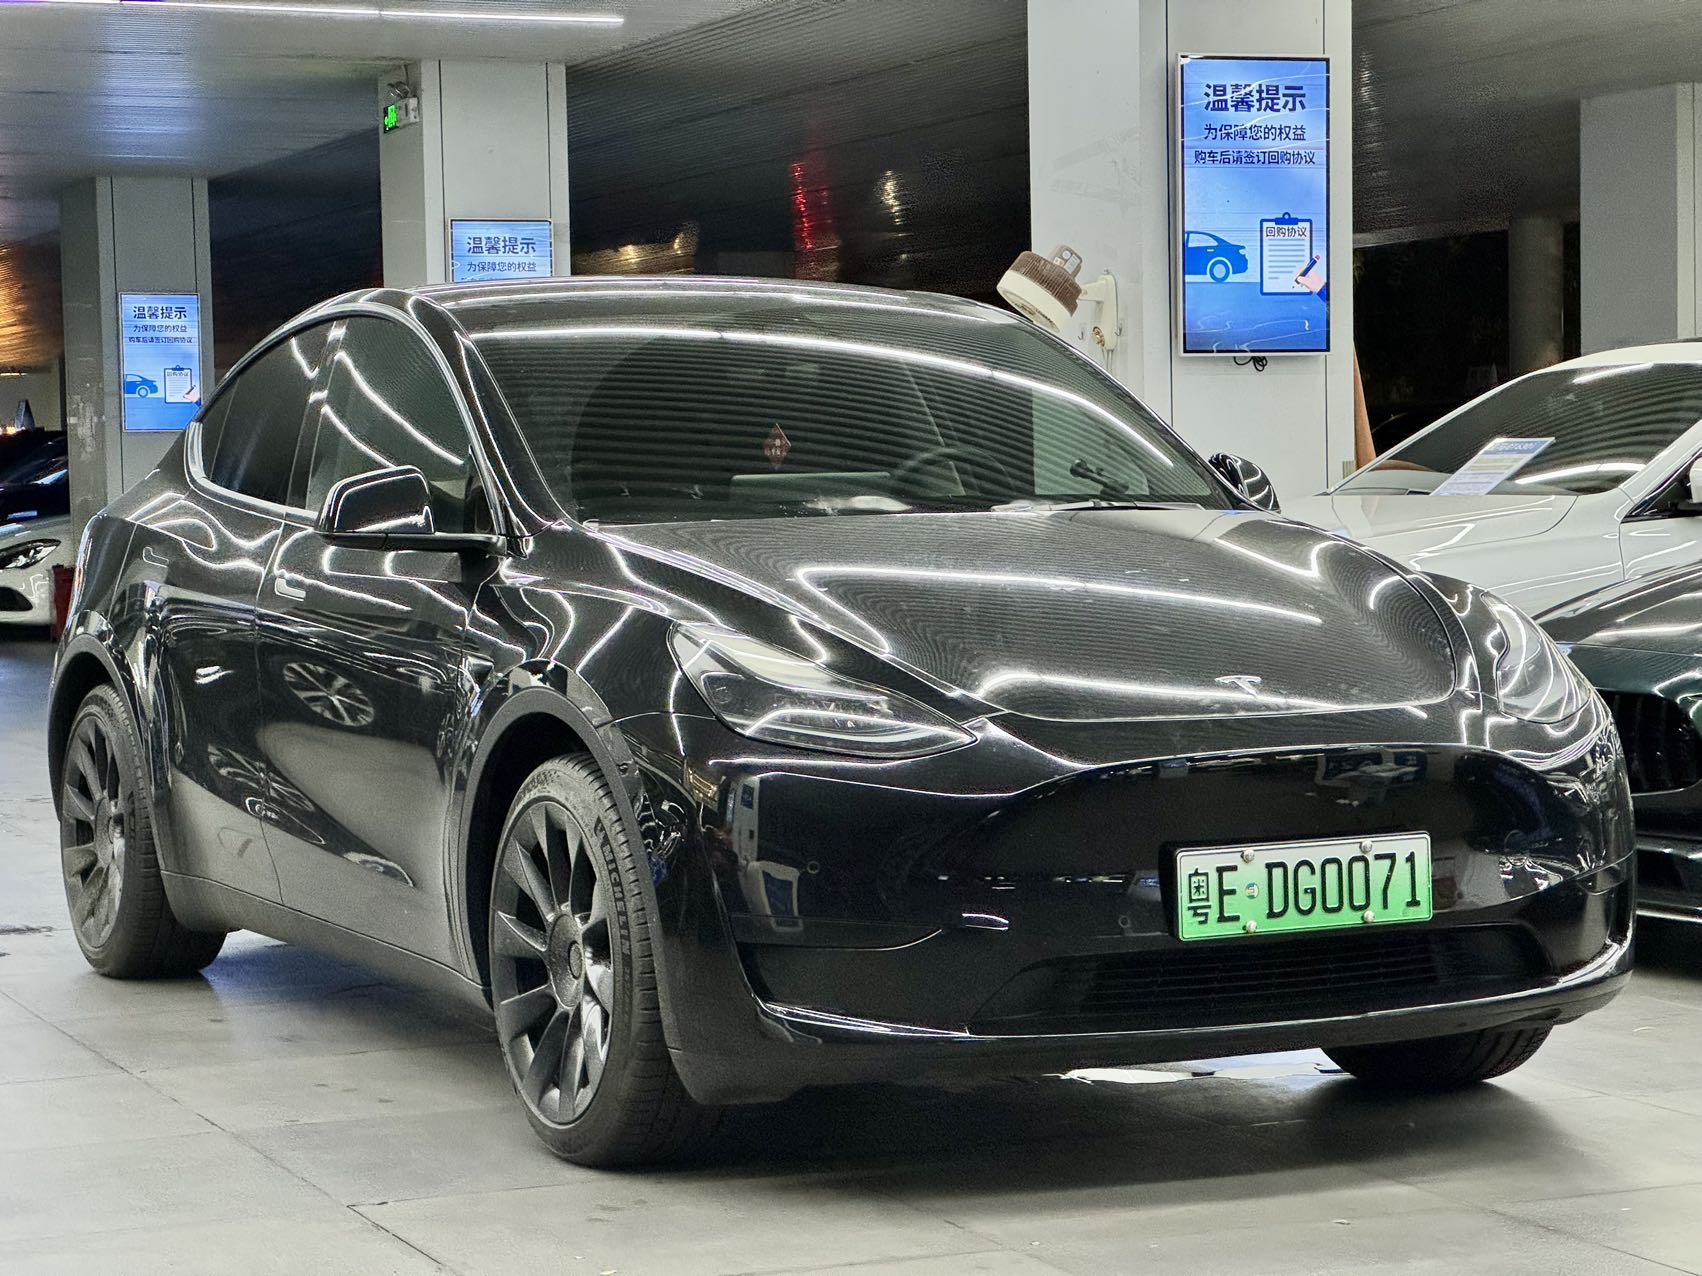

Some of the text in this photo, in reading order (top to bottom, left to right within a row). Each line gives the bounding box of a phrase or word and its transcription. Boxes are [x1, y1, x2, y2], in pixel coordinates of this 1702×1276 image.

[1204, 83, 1306, 113] 温馨提示
[1203, 124, 1306, 141] 为保障您的权益
[1194, 150, 1315, 165] 购车后请签订回购协议
[1265, 225, 1307, 238] 回购协议
[467, 236, 536, 254] 温馨提示
[467, 261, 537, 272] 为保障您的权益
[133, 306, 187, 319] 温馨提示
[1187, 850, 1421, 925] 粤E DG0071
